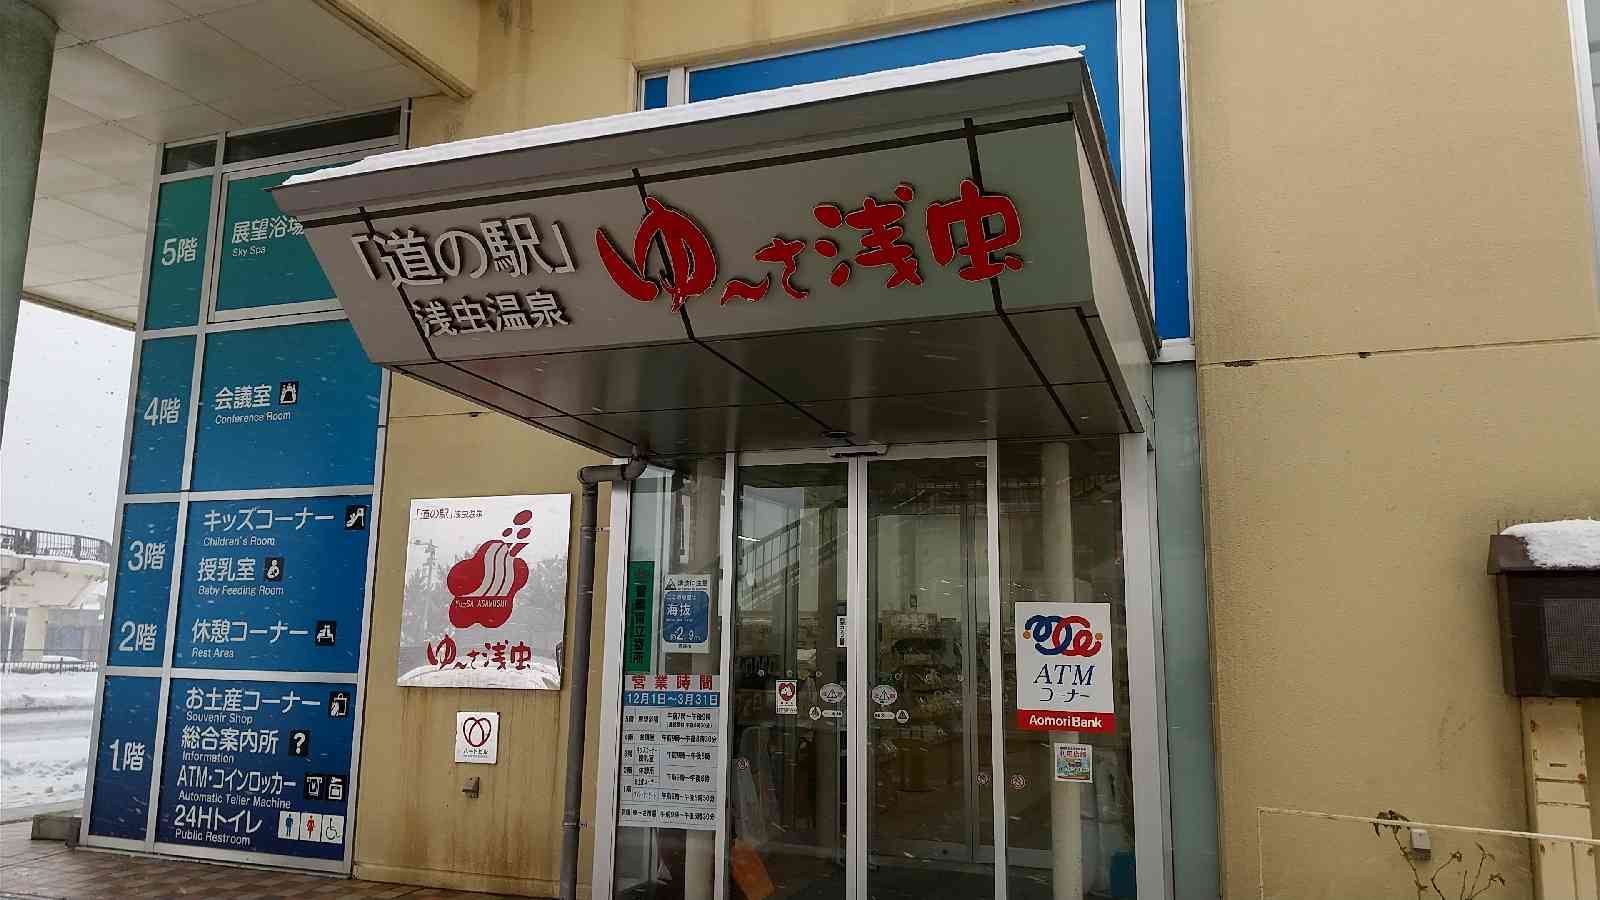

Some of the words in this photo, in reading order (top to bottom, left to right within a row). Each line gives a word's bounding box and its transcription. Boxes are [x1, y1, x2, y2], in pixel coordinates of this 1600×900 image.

[161, 236, 199, 266] 5階
[232, 246, 248, 257] Sky
[250, 245, 266, 256] Spa
[352, 214, 575, 288] 「道の駅」
[415, 287, 570, 338] 浅虫温泉
[215, 384, 272, 411] 会議室
[143, 396, 181, 426] 4階
[215, 413, 264, 425] Conference
[266, 411, 291, 423] Room
[203, 506, 335, 533] キッズコーナー
[203, 536, 248, 547] Children's
[250, 535, 276, 546] Room
[127, 540, 166, 572] 3階
[197, 557, 256, 582] 授乳室
[198, 585, 220, 596] Baby
[222, 585, 257, 597] Feeding
[259, 585, 284, 596] Room
[666, 603, 691, 617] 海抜
[119, 620, 158, 652] 2階
[191, 618, 309, 645] 休憩コーナー
[192, 648, 212, 659] Rest
[213, 649, 235, 659] Area
[632, 672, 713, 690] 営業時間
[1033, 663, 1096, 685] ATM
[186, 686, 321, 714] お土産コーナー
[186, 711, 227, 723] Souvenir
[229, 713, 254, 725] Shop
[181, 725, 280, 755] 総合案内所
[109, 738, 147, 772] 1階
[182, 751, 235, 764] Information
[178, 790, 223, 804] Automatic
[226, 793, 251, 806] Teller
[253, 796, 292, 810] Machine
[173, 804, 263, 834] 24Hトイレ
[175, 828, 204, 842] Public
[205, 831, 251, 846] Restroom
